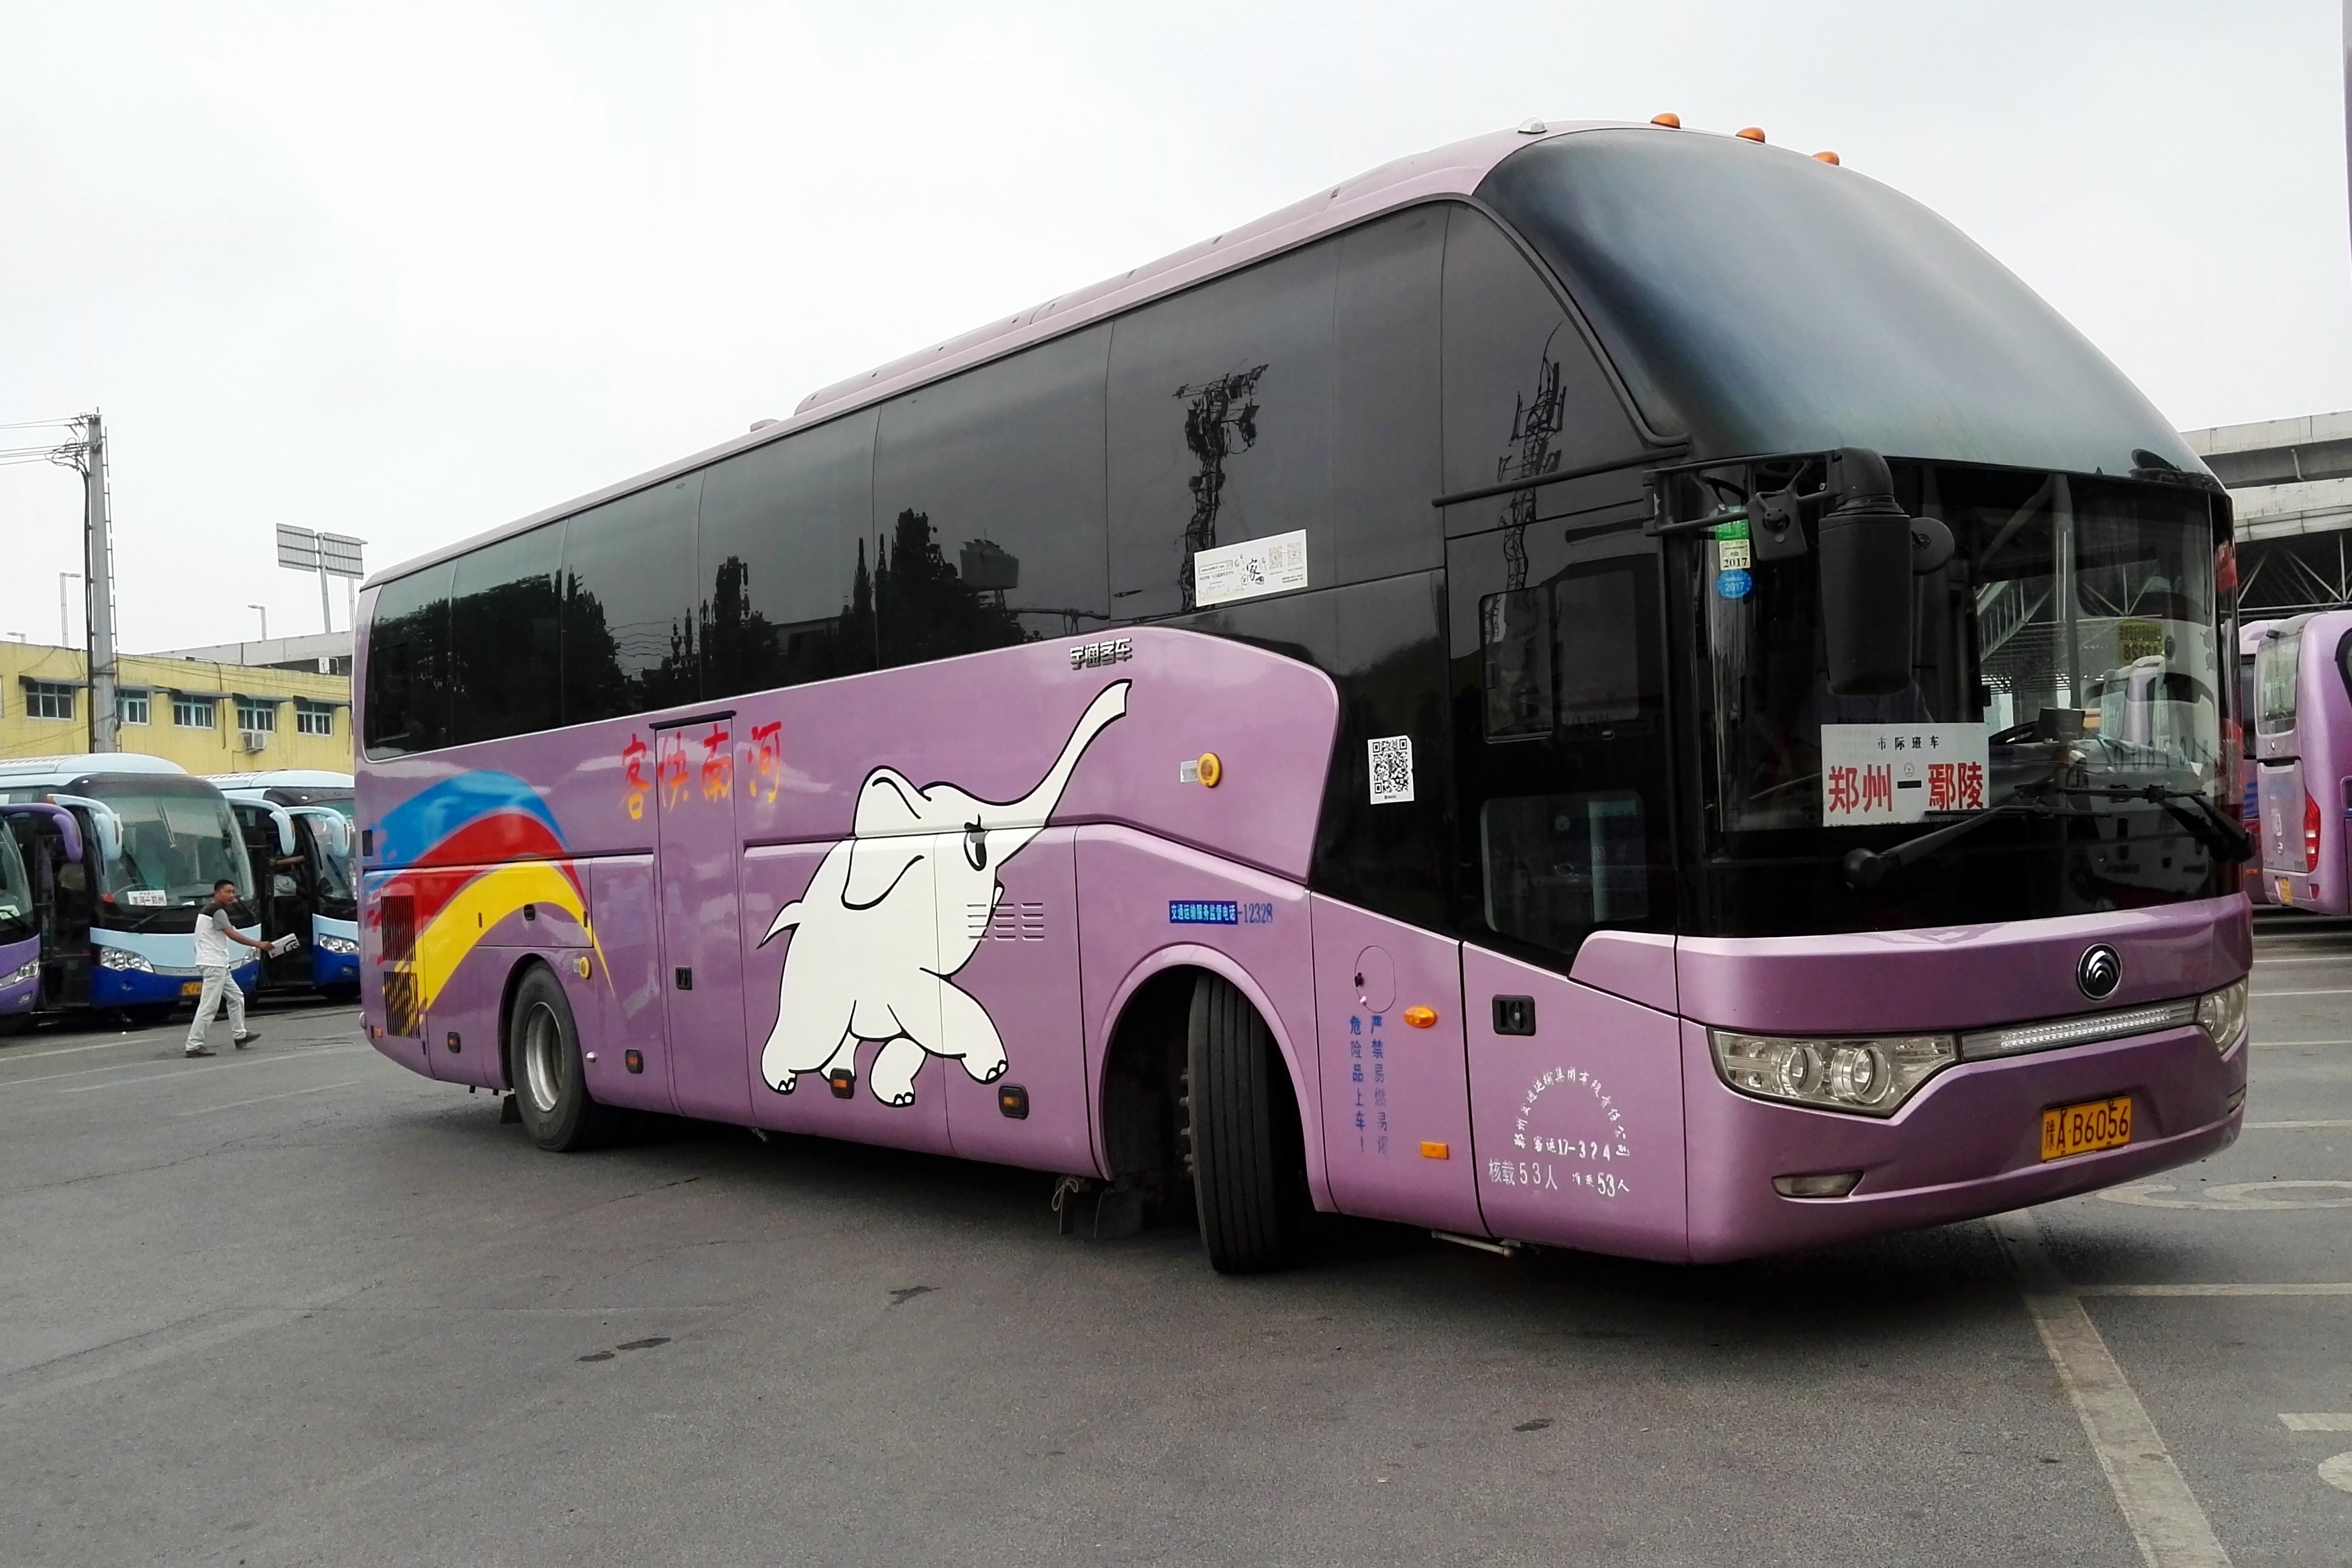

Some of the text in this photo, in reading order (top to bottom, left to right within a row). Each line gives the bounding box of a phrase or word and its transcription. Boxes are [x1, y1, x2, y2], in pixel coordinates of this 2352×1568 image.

[1723, 558, 1748, 568] 2017
[1725, 582, 1745, 591] 2017
[1069, 637, 1132, 670] 宇通客车
[1877, 735, 1940, 751] 市际班车
[1370, 1015, 1389, 1155] 严禁易燃易爆
[1488, 1158, 1559, 1191] 核载53人
